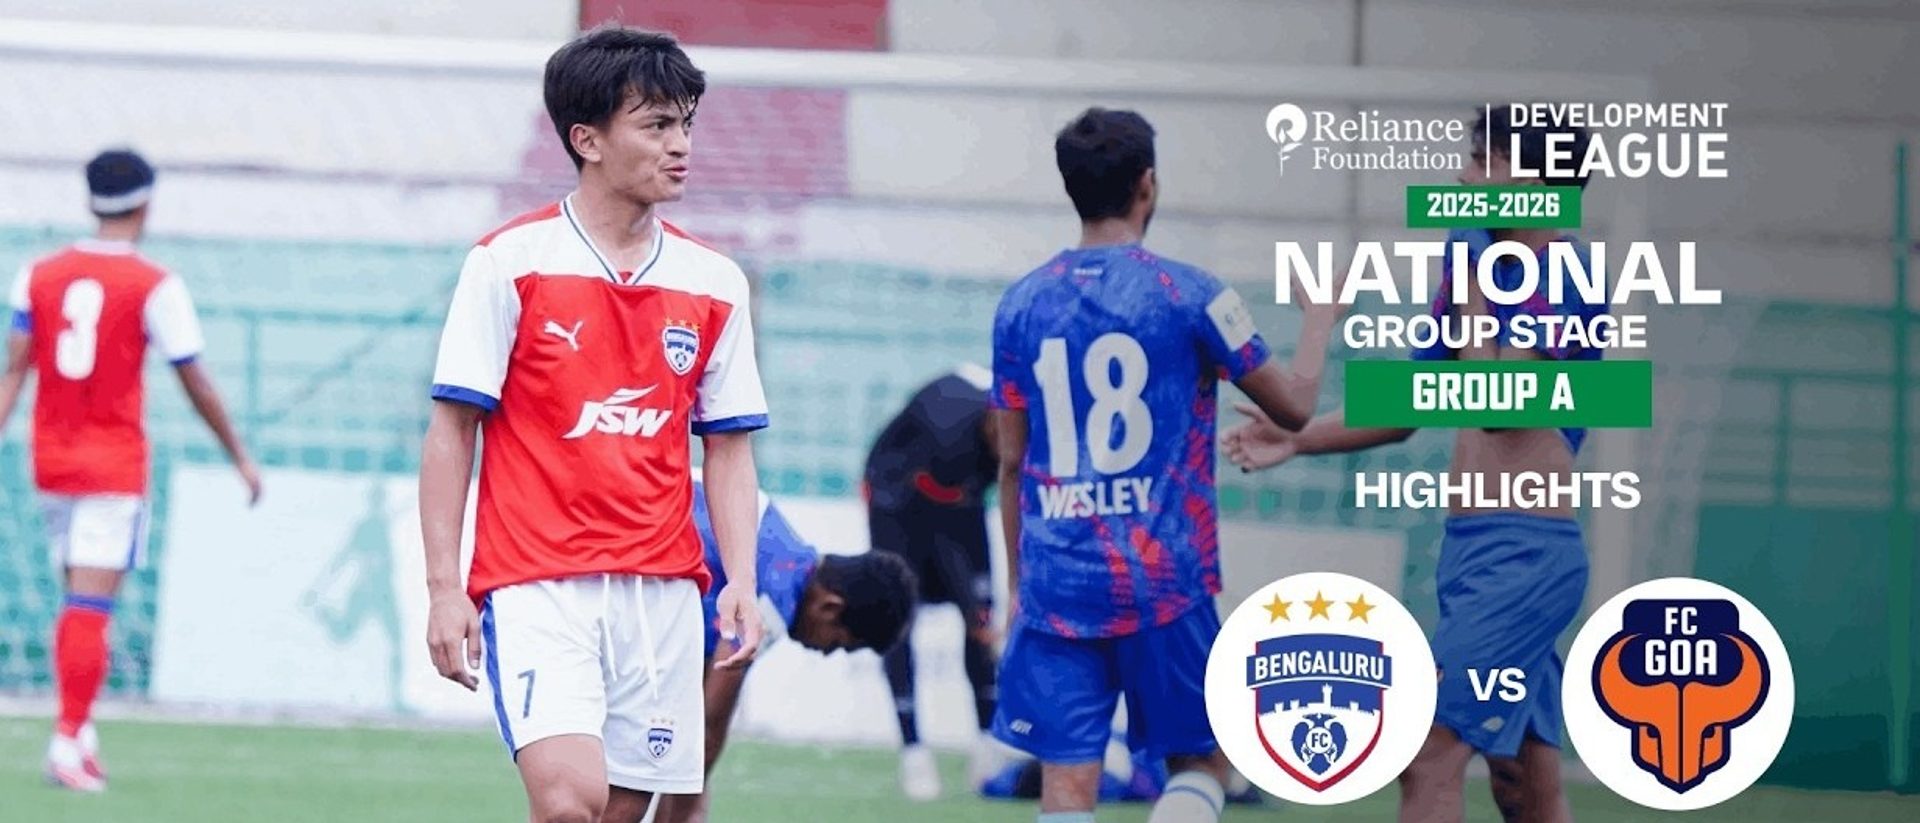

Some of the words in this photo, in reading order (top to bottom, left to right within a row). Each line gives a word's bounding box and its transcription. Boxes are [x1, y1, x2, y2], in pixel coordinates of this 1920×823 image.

[56, 278, 105, 381] 3
[561, 400, 673, 440] JSW
[1033, 332, 1154, 478] 18
[1037, 476, 1153, 521] WESLEY
[517, 668, 536, 719] 7
